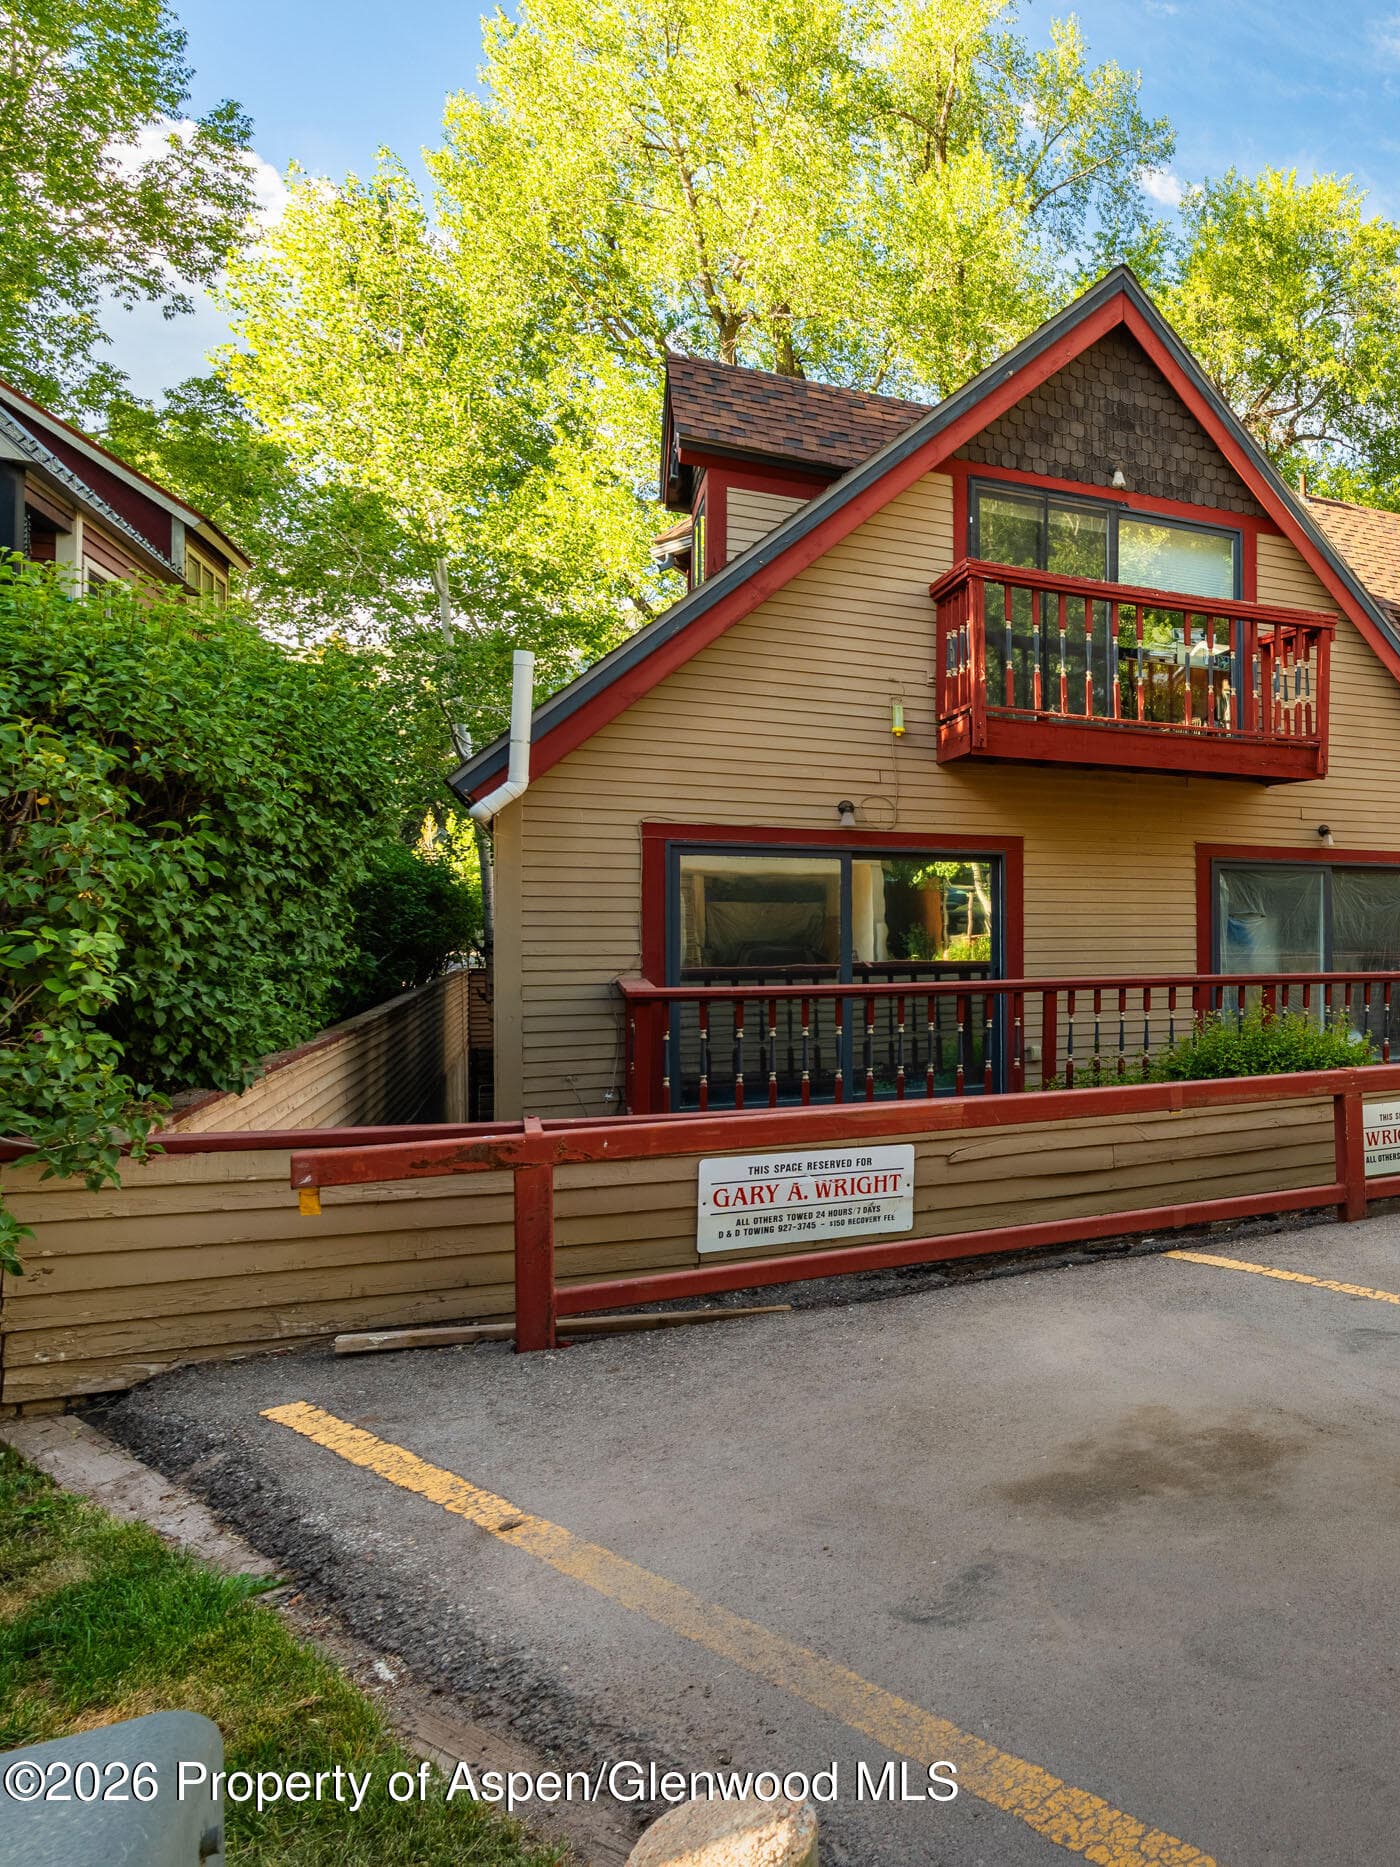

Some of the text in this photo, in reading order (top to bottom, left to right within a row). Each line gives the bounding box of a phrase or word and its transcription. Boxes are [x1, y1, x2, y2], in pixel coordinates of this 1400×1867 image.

[748, 1157, 872, 1176] THIS SPACE RESERVED FOR
[1366, 1156, 1376, 1164] ALL
[1378, 1152, 1400, 1162] OTHERS
[713, 1174, 902, 1208] GARY A. WRIGHT
[718, 1231, 724, 1239] D
[735, 1229, 740, 1237] D
[744, 1226, 774, 1236] TOWING
[778, 1222, 816, 1233] 927-3745
[830, 1219, 845, 1227] $150
[848, 1215, 881, 1225] RECOVERY
[736, 1218, 750, 1227] ALL
[753, 1215, 783, 1225] OTHERS
[787, 1212, 813, 1222] TOWED
[816, 1210, 825, 1219] 24
[863, 1205, 881, 1214] DAYS
